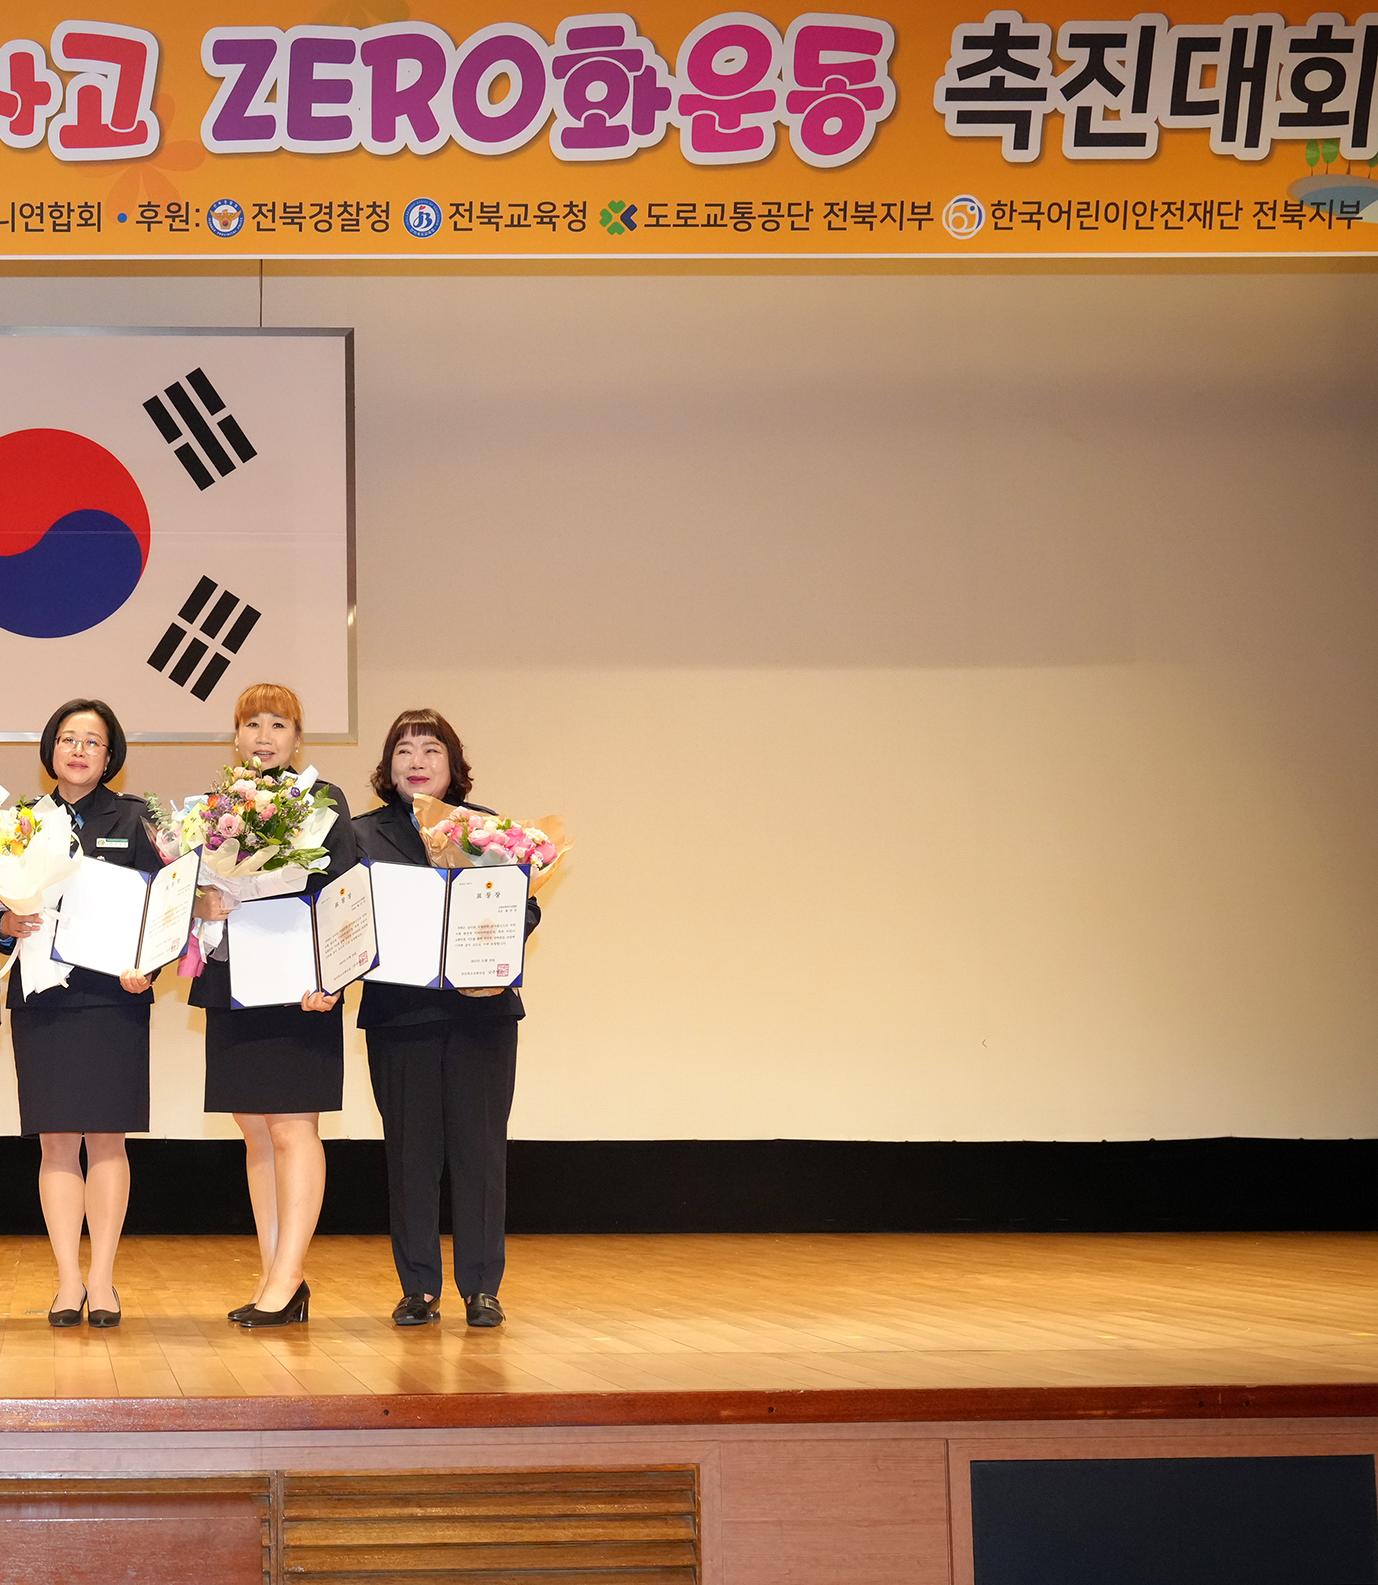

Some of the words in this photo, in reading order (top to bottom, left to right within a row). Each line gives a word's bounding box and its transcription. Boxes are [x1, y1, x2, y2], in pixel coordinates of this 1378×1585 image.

[211, 24, 885, 157] ZERO화운동
[944, 22, 1378, 151] 촉진대회
[134, 200, 200, 233] 후원:
[250, 200, 390, 233] 전북경찰청
[447, 200, 587, 233] 전북교육청
[643, 199, 814, 232] 도로교통공단
[822, 199, 935, 232] 전북지부
[989, 199, 1244, 232] 한국어린이안전재단
[1252, 198, 1364, 231] 전북지부
